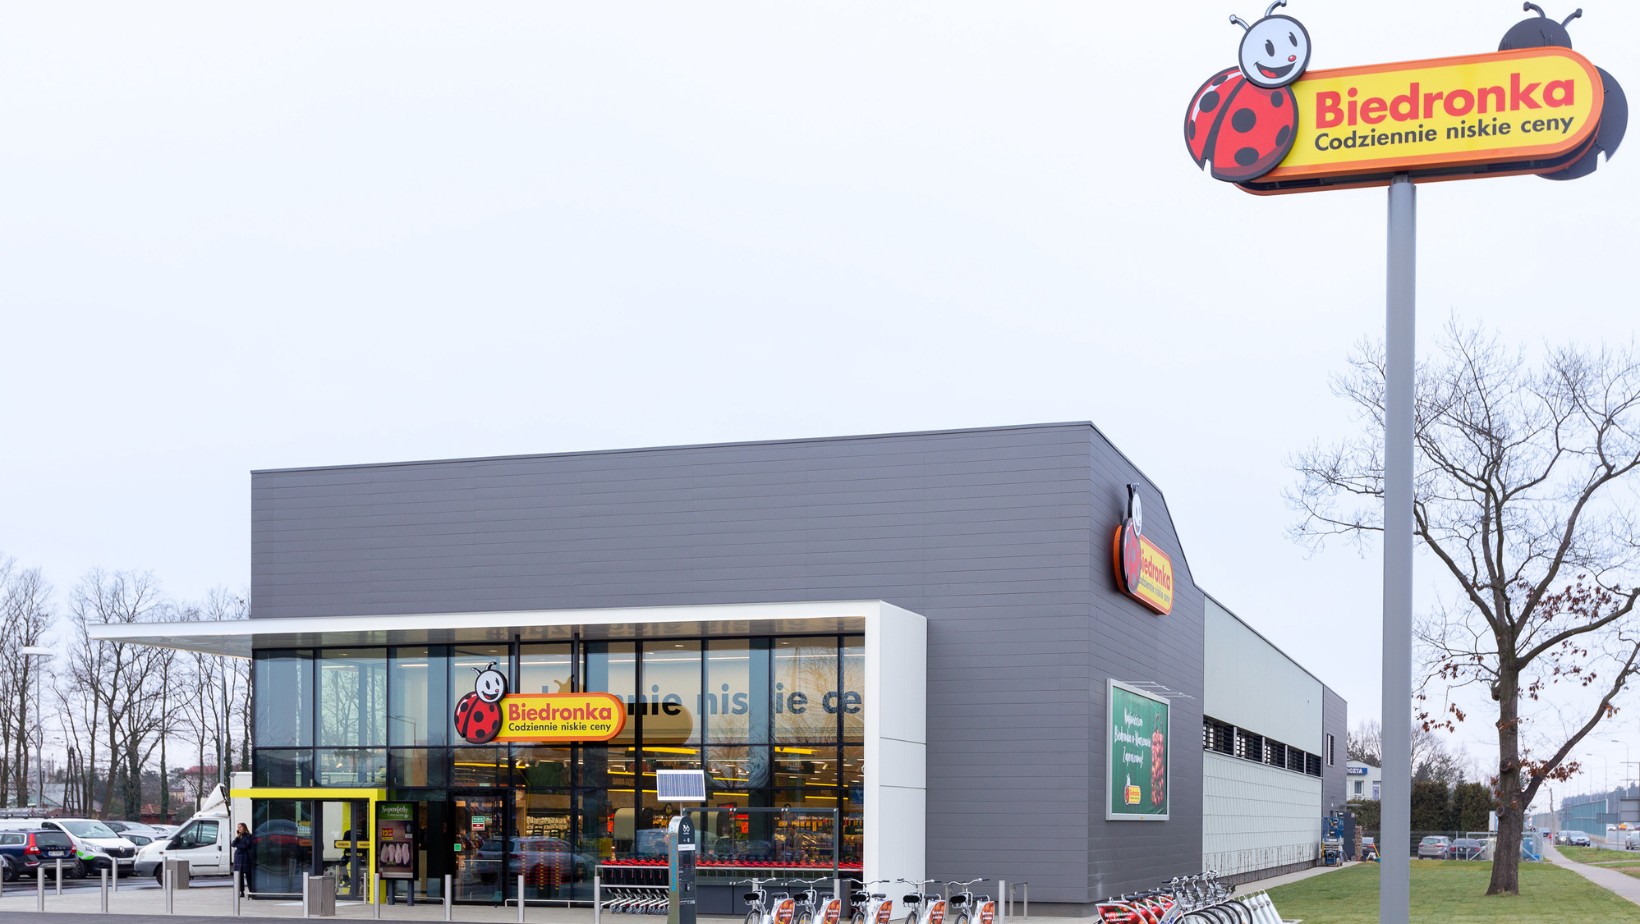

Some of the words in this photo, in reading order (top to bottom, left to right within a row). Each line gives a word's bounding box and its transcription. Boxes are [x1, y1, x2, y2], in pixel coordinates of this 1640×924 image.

[1316, 73, 1575, 129] Biedronka
[1315, 124, 1438, 151] Codziennie
[1446, 117, 1511, 139] niskie
[1521, 117, 1574, 134] ceny
[1141, 549, 1170, 590] iedronka
[508, 702, 612, 721] Biedronka
[697, 682, 808, 715] nisie
[508, 722, 558, 732] Codziennie
[561, 722, 587, 731] niskie
[590, 723, 611, 732] ceny
